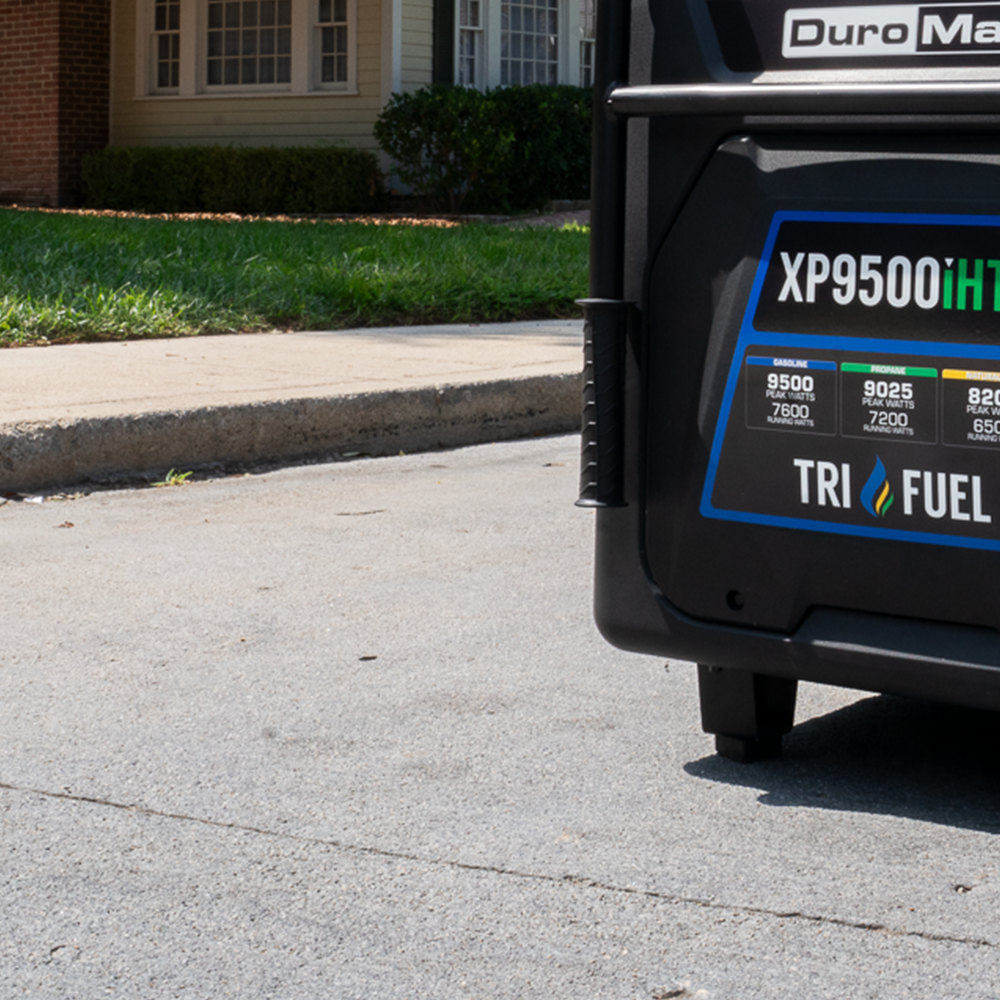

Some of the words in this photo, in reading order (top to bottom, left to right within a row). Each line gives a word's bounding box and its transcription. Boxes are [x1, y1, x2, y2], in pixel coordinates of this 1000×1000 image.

[773, 358, 808, 368] GASOLINE
[870, 364, 907, 375] PROPANE
[767, 373, 814, 392] 9500
[765, 389, 786, 400] PEAK
[787, 391, 816, 402] WATTS
[863, 379, 914, 400] 9025
[861, 397, 884, 407] PEAK
[885, 398, 915, 410] WATTS
[966, 405, 990, 415] PEAK
[771, 402, 810, 419] 7600
[766, 415, 793, 426] RUNNING
[794, 417, 815, 428] WATTS
[869, 410, 909, 427] 7200
[863, 424, 891, 434] RUNNING
[892, 425, 914, 436] WATTS
[967, 432, 997, 443] RUNNING
[793, 458, 852, 509] TRI
[902, 469, 992, 523] FUEL
